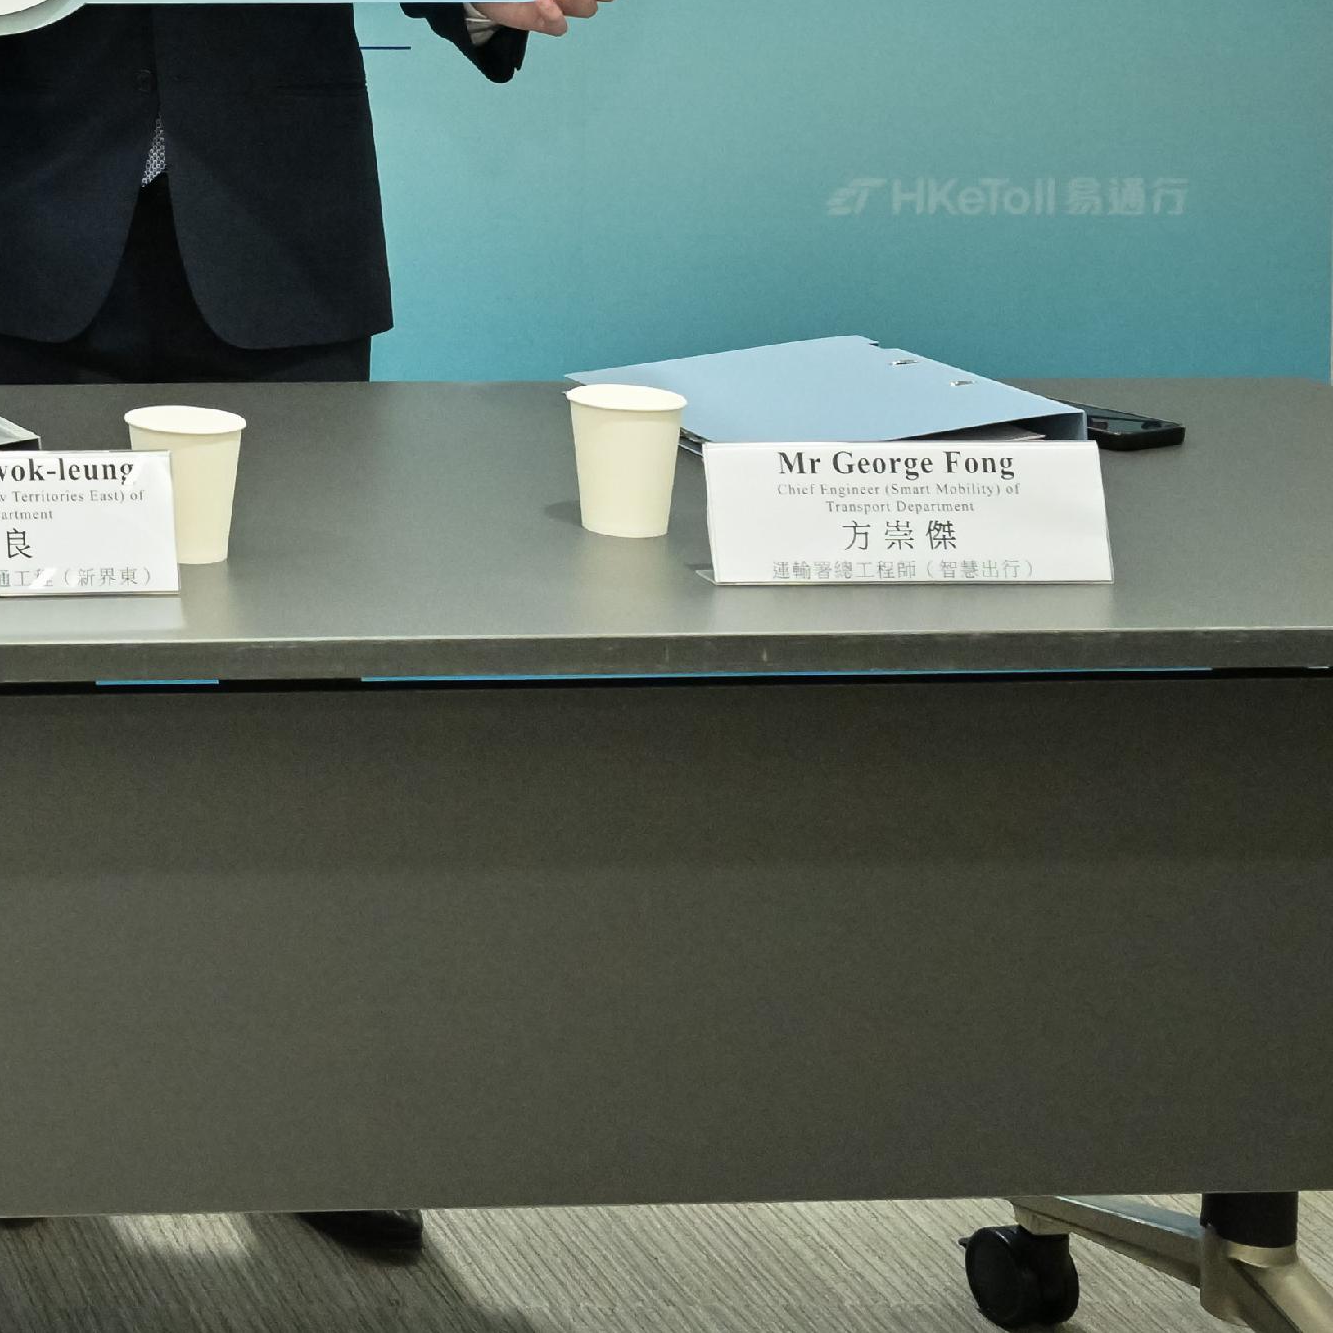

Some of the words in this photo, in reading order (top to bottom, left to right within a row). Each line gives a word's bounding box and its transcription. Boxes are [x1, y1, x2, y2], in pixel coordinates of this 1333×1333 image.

[891, 177, 1056, 216] HKeToll
[1065, 177, 1189, 216] 易通行
[778, 450, 821, 475] Mr
[831, 450, 934, 481] George
[942, 450, 1016, 481] Fong
[12, 490, 84, 504] Territories
[90, 489, 126, 504] East)
[129, 489, 146, 502] of
[776, 482, 815, 496] Chief
[820, 483, 880, 498] Engineer
[885, 482, 931, 497] (Smart
[936, 482, 1001, 497] Mobility)
[1005, 482, 1021, 496] of
[825, 499, 891, 513] Transport
[896, 499, 975, 513] Department
[842, 519, 958, 552] 方崇傑
